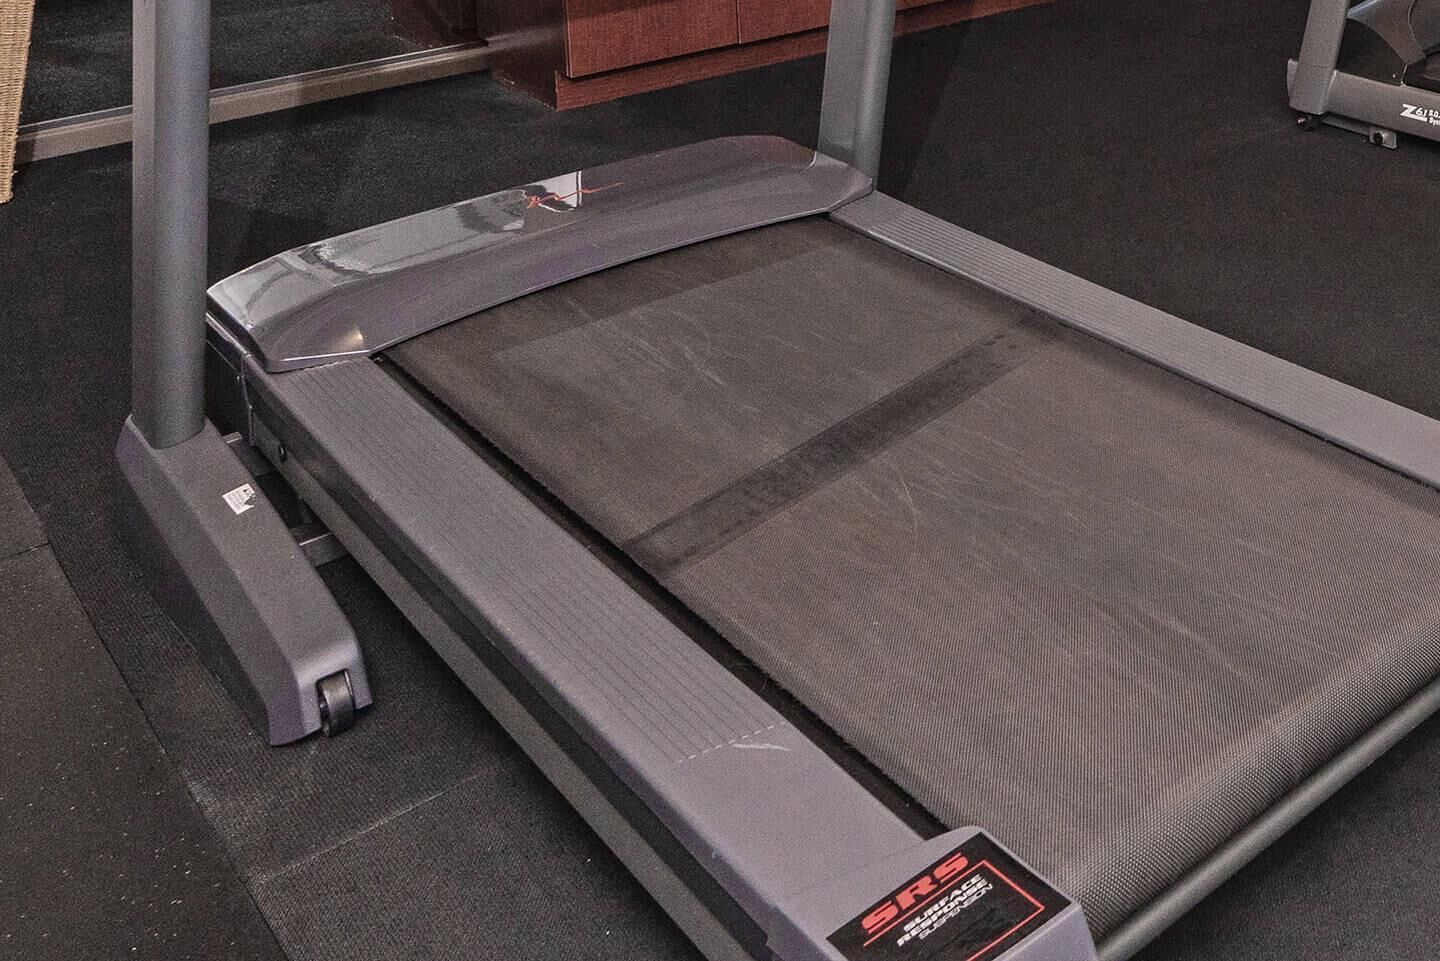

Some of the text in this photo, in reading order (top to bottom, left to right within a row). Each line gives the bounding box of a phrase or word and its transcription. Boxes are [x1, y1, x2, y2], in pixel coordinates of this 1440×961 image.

[861, 852, 970, 935] SRS
[896, 878, 988, 947] RESPONSE
[903, 873, 983, 932] SURFACE
[918, 883, 994, 940] SUSPENSION
